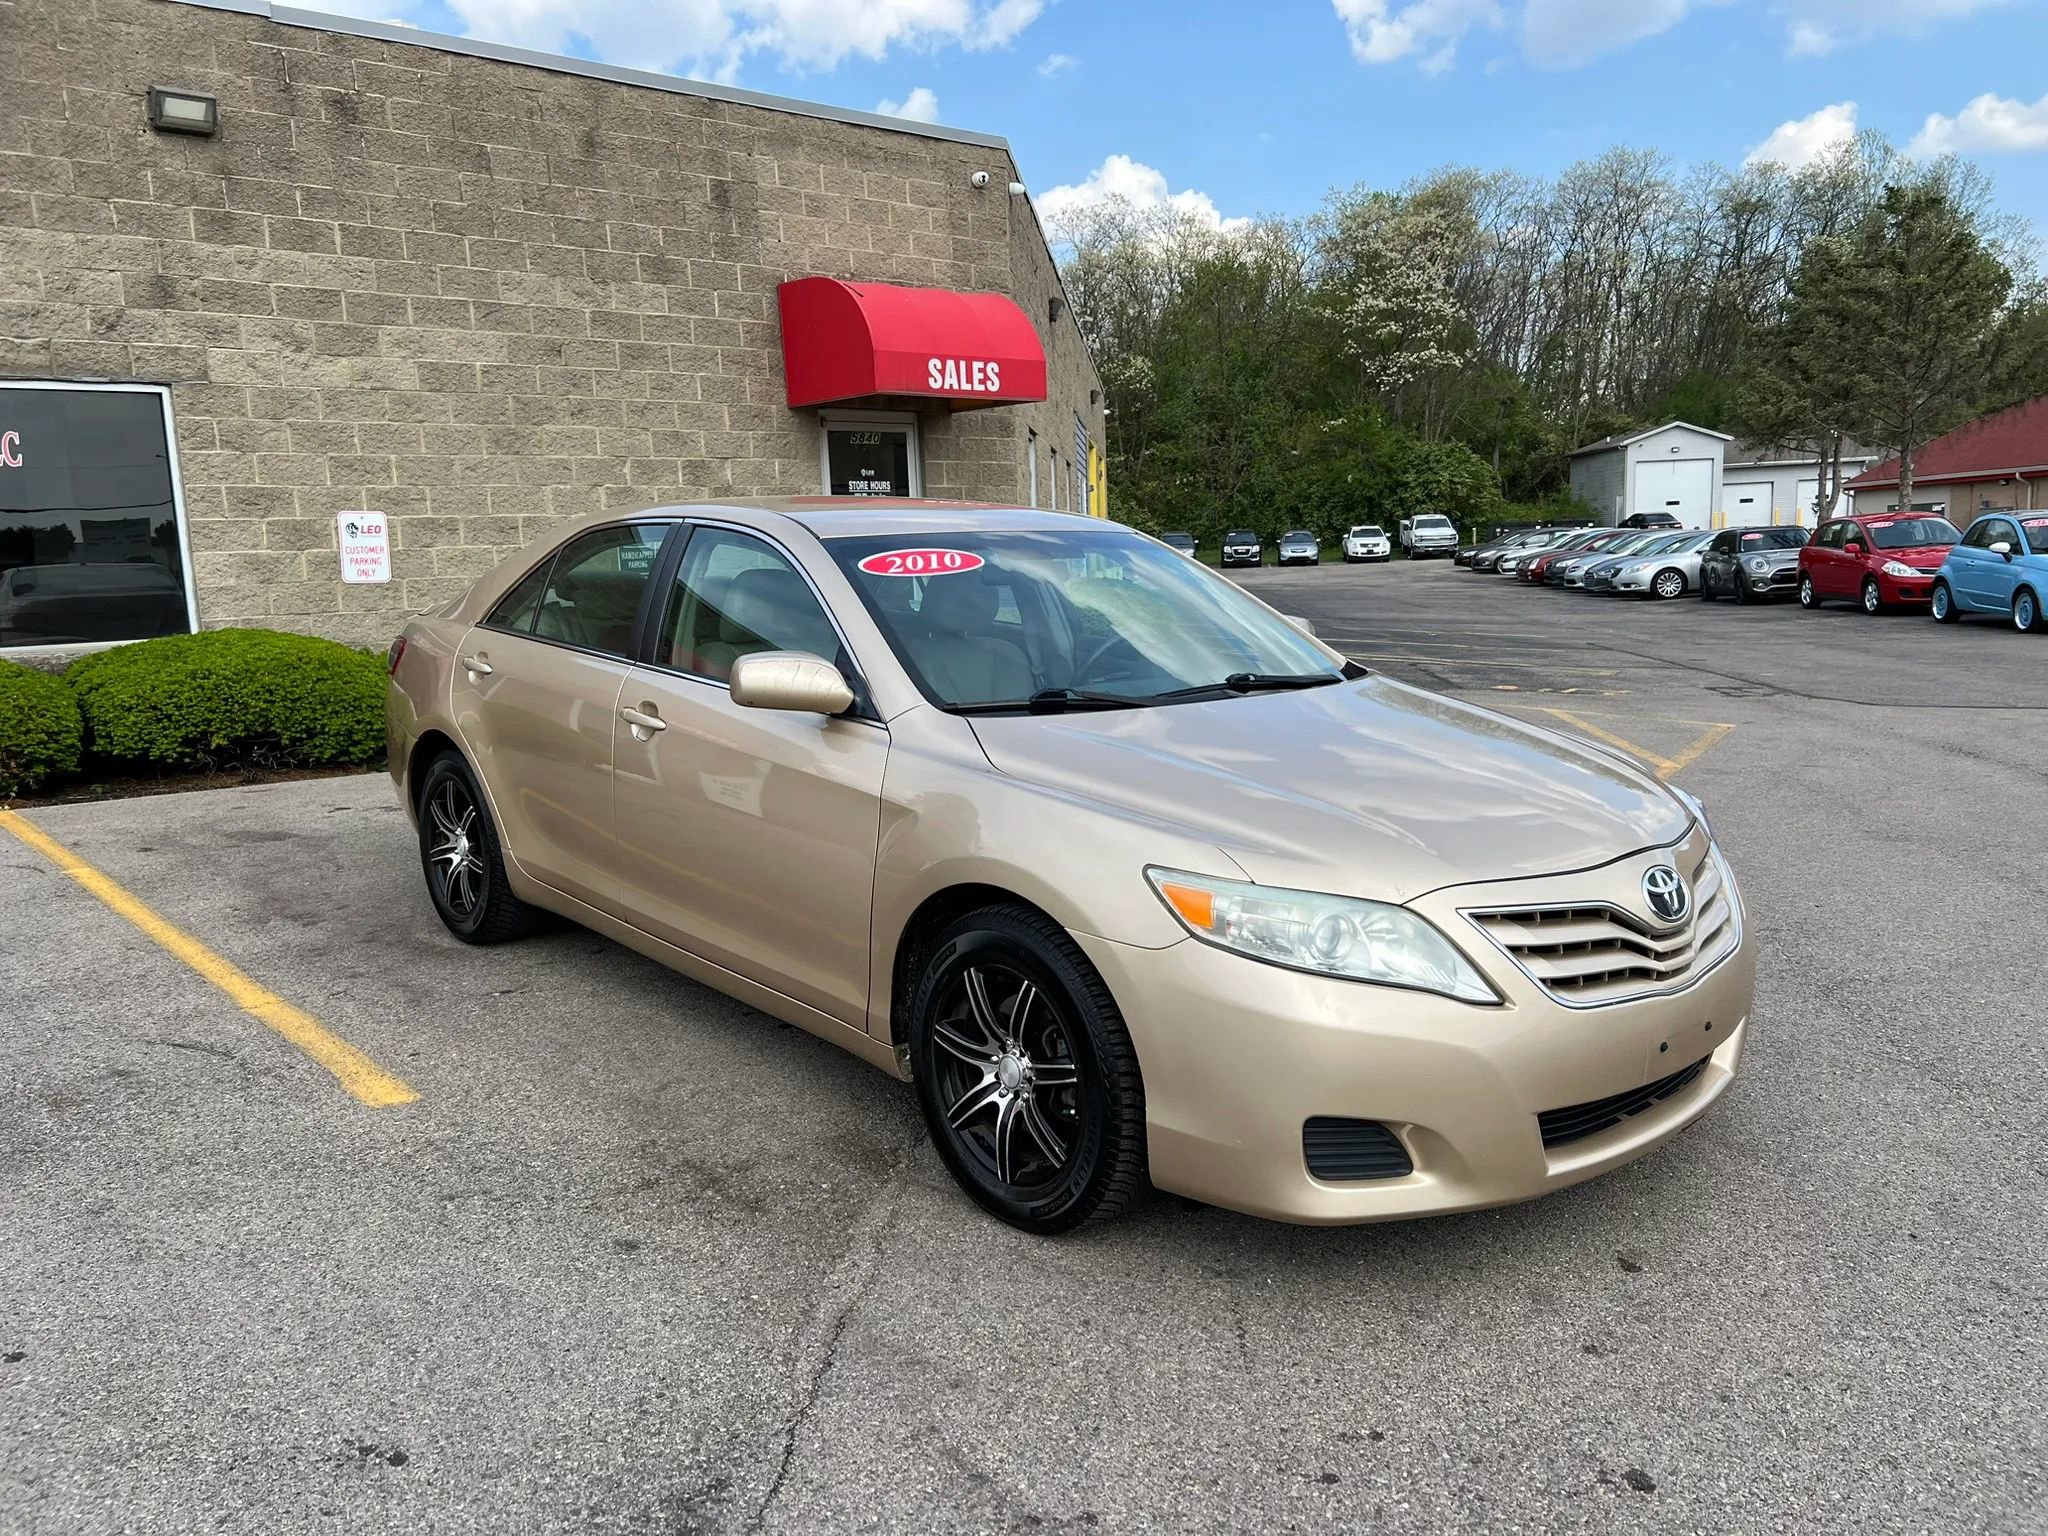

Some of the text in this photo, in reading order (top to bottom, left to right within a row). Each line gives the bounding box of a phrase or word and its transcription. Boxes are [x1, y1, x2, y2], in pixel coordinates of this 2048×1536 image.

[928, 358, 1000, 392] SALES
[851, 432, 880, 443] 5840
[848, 481, 891, 490] STORE HOURS
[361, 525, 381, 534] LEO
[345, 546, 385, 555] CUSTOMER
[350, 557, 382, 566] PARKING
[885, 551, 962, 574] 2010
[357, 568, 376, 577] ONLY
